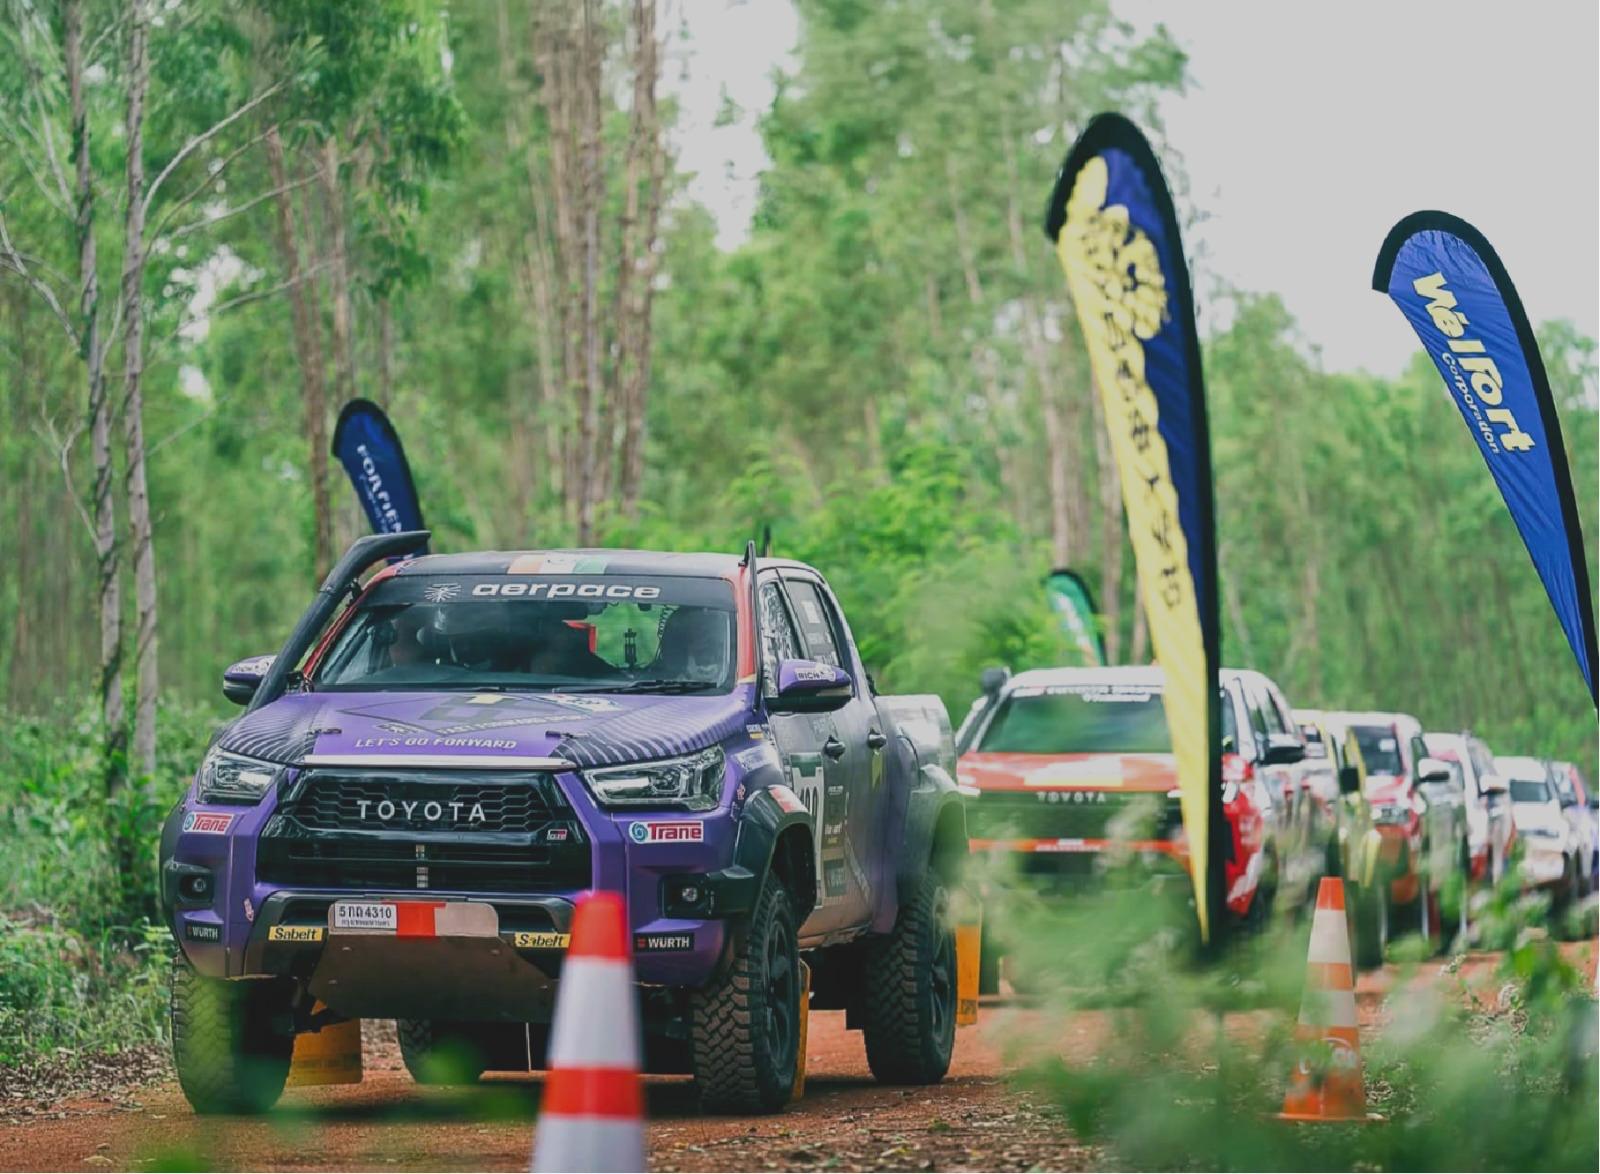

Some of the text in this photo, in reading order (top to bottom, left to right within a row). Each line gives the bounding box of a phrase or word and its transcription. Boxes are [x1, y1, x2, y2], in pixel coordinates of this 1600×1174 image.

[471, 582, 661, 599] aerpace
[354, 736, 518, 749] LET'S GO FORWARD
[356, 799, 487, 822] TOYOTA
[192, 813, 234, 832] Trane
[647, 822, 703, 841] Trane
[274, 927, 317, 940] Sabelt
[517, 933, 565, 947] Sabelt
